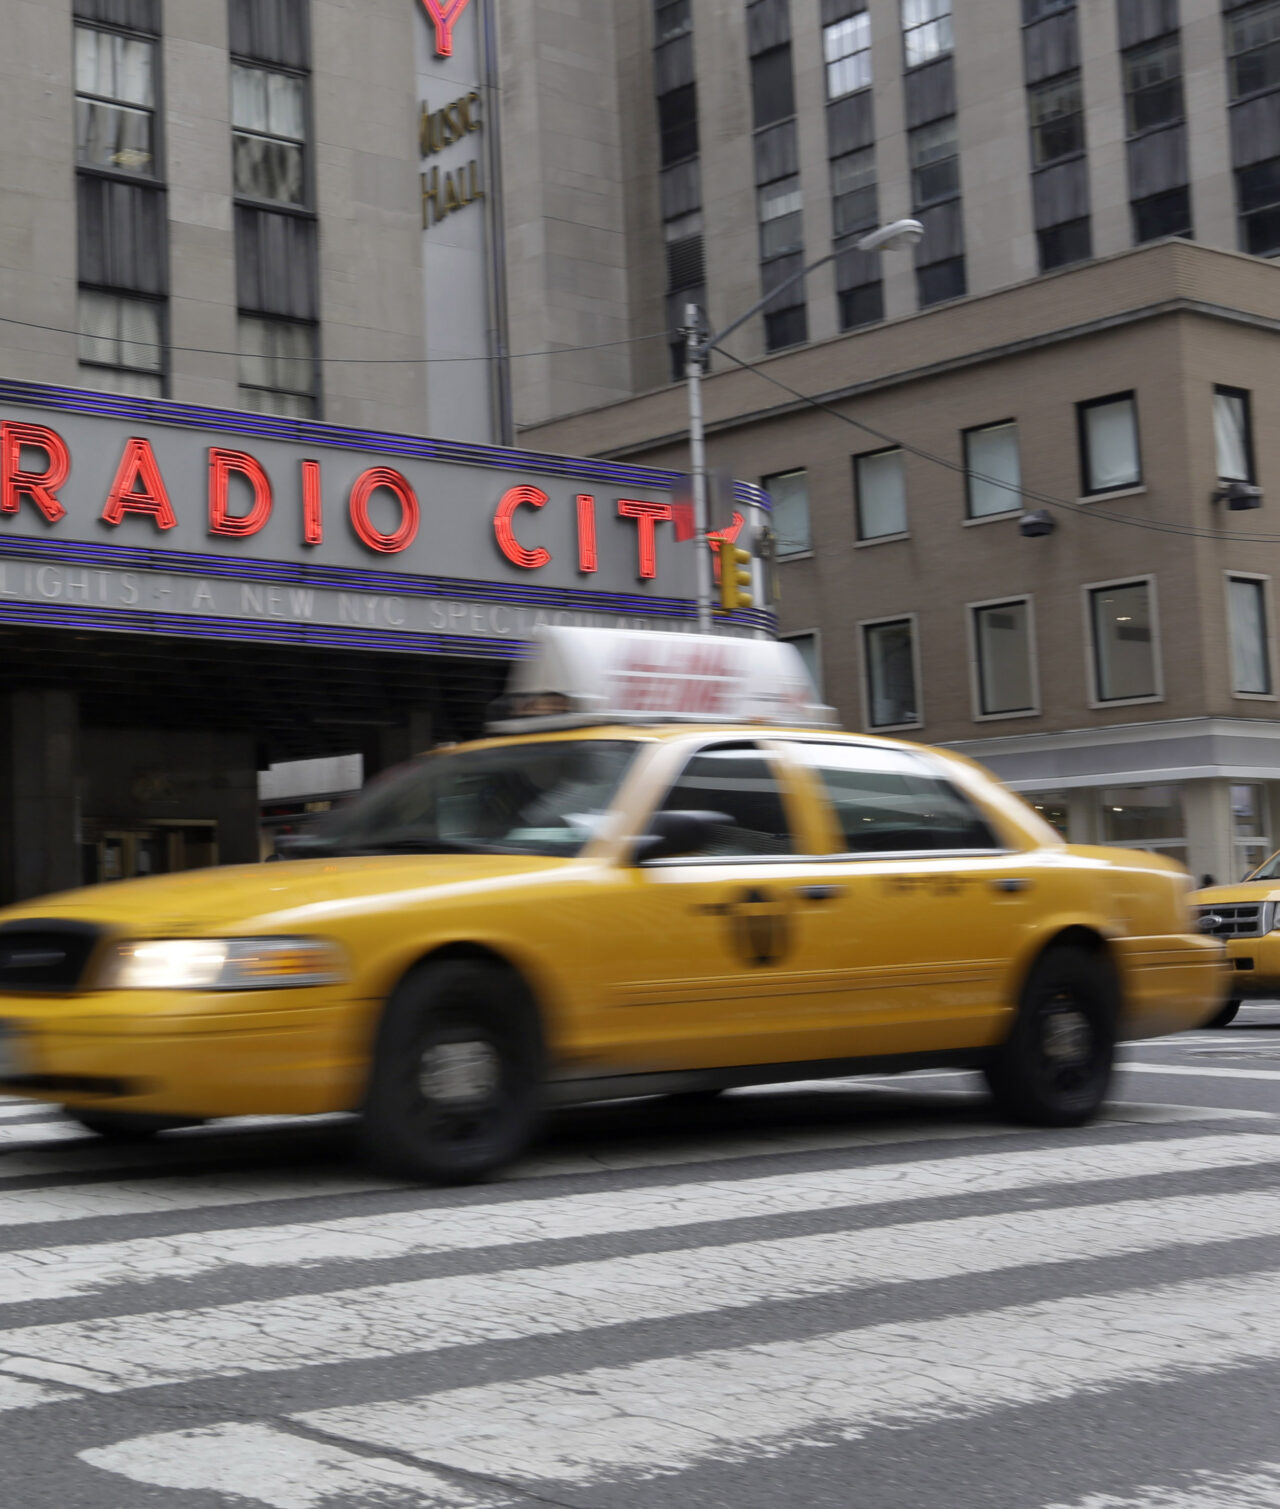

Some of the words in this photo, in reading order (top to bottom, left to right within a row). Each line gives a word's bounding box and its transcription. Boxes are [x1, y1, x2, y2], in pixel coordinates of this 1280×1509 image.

[191, 579, 217, 611] A
[239, 582, 316, 619] NEW
[337, 592, 406, 626] NYC
